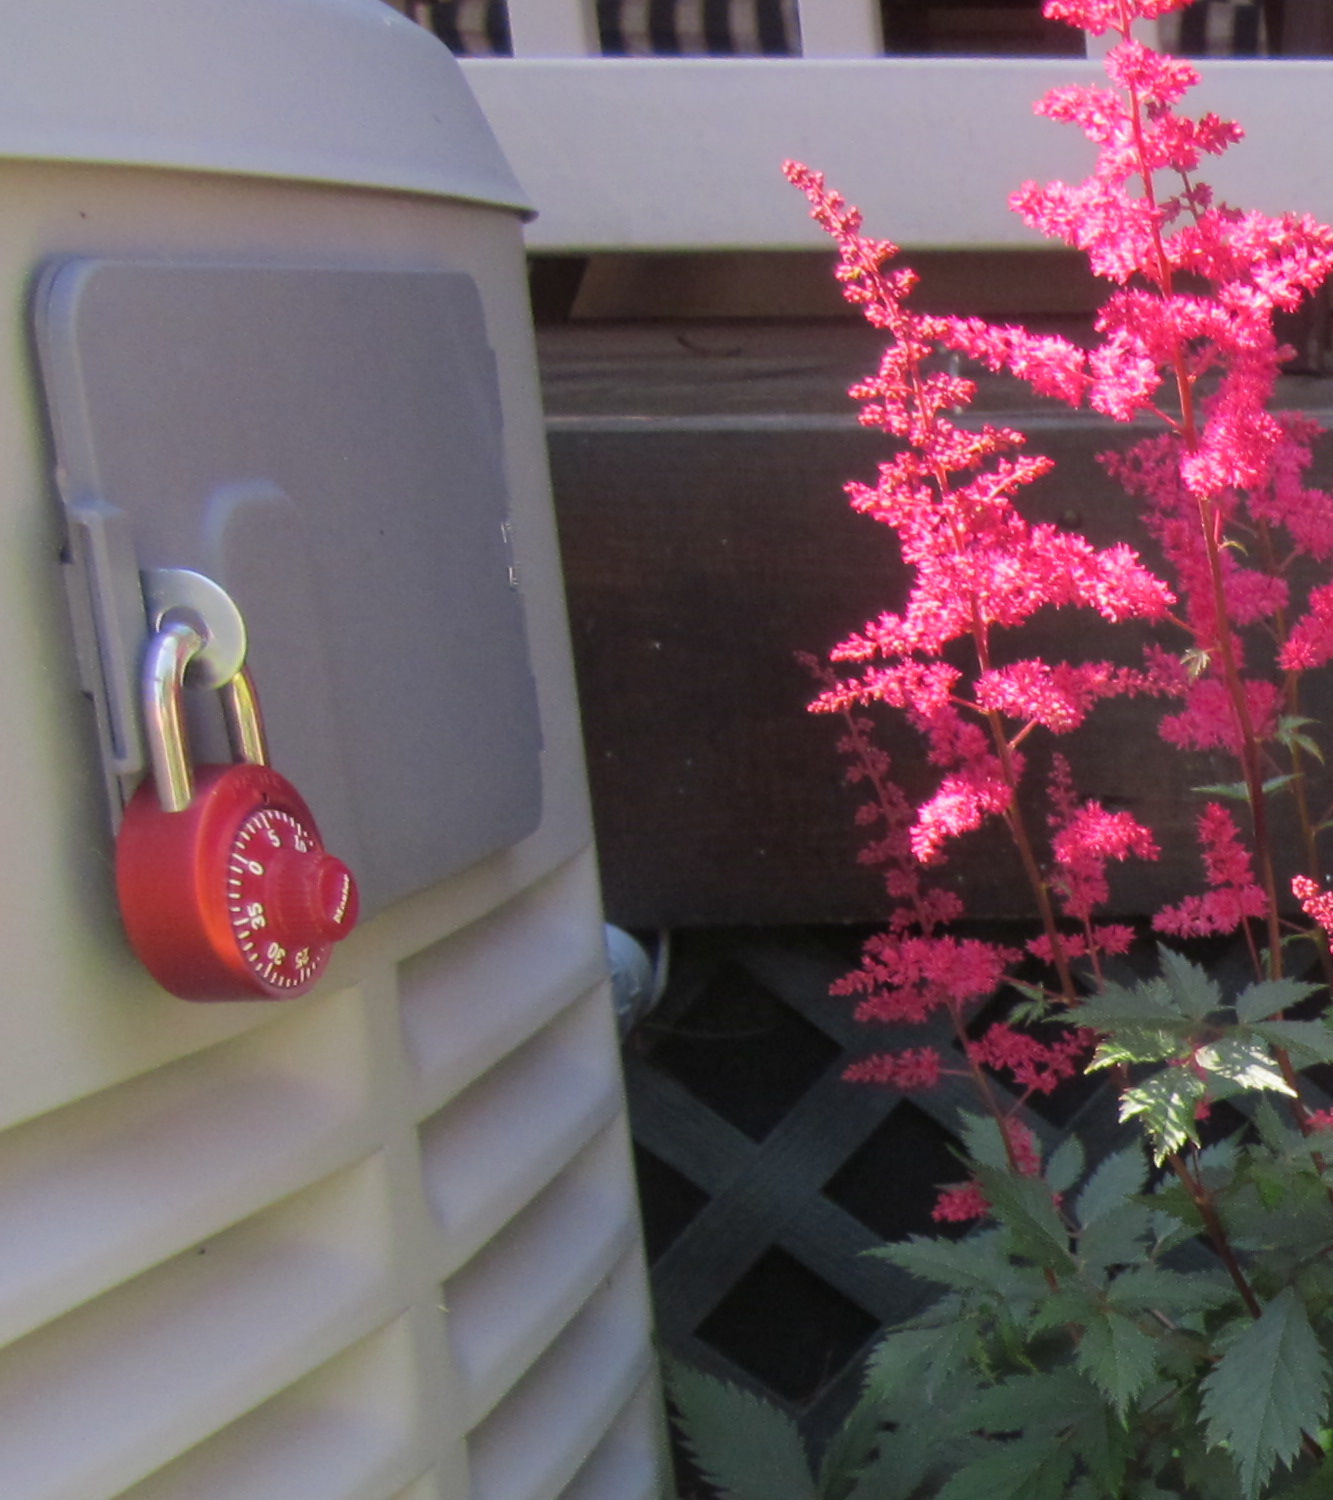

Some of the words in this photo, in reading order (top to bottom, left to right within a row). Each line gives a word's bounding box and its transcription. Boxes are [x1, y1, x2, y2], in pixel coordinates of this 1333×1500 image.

[267, 829, 281, 848] 5
[248, 861, 264, 875] 0
[246, 902, 266, 930] 35
[267, 941, 286, 966] 30
